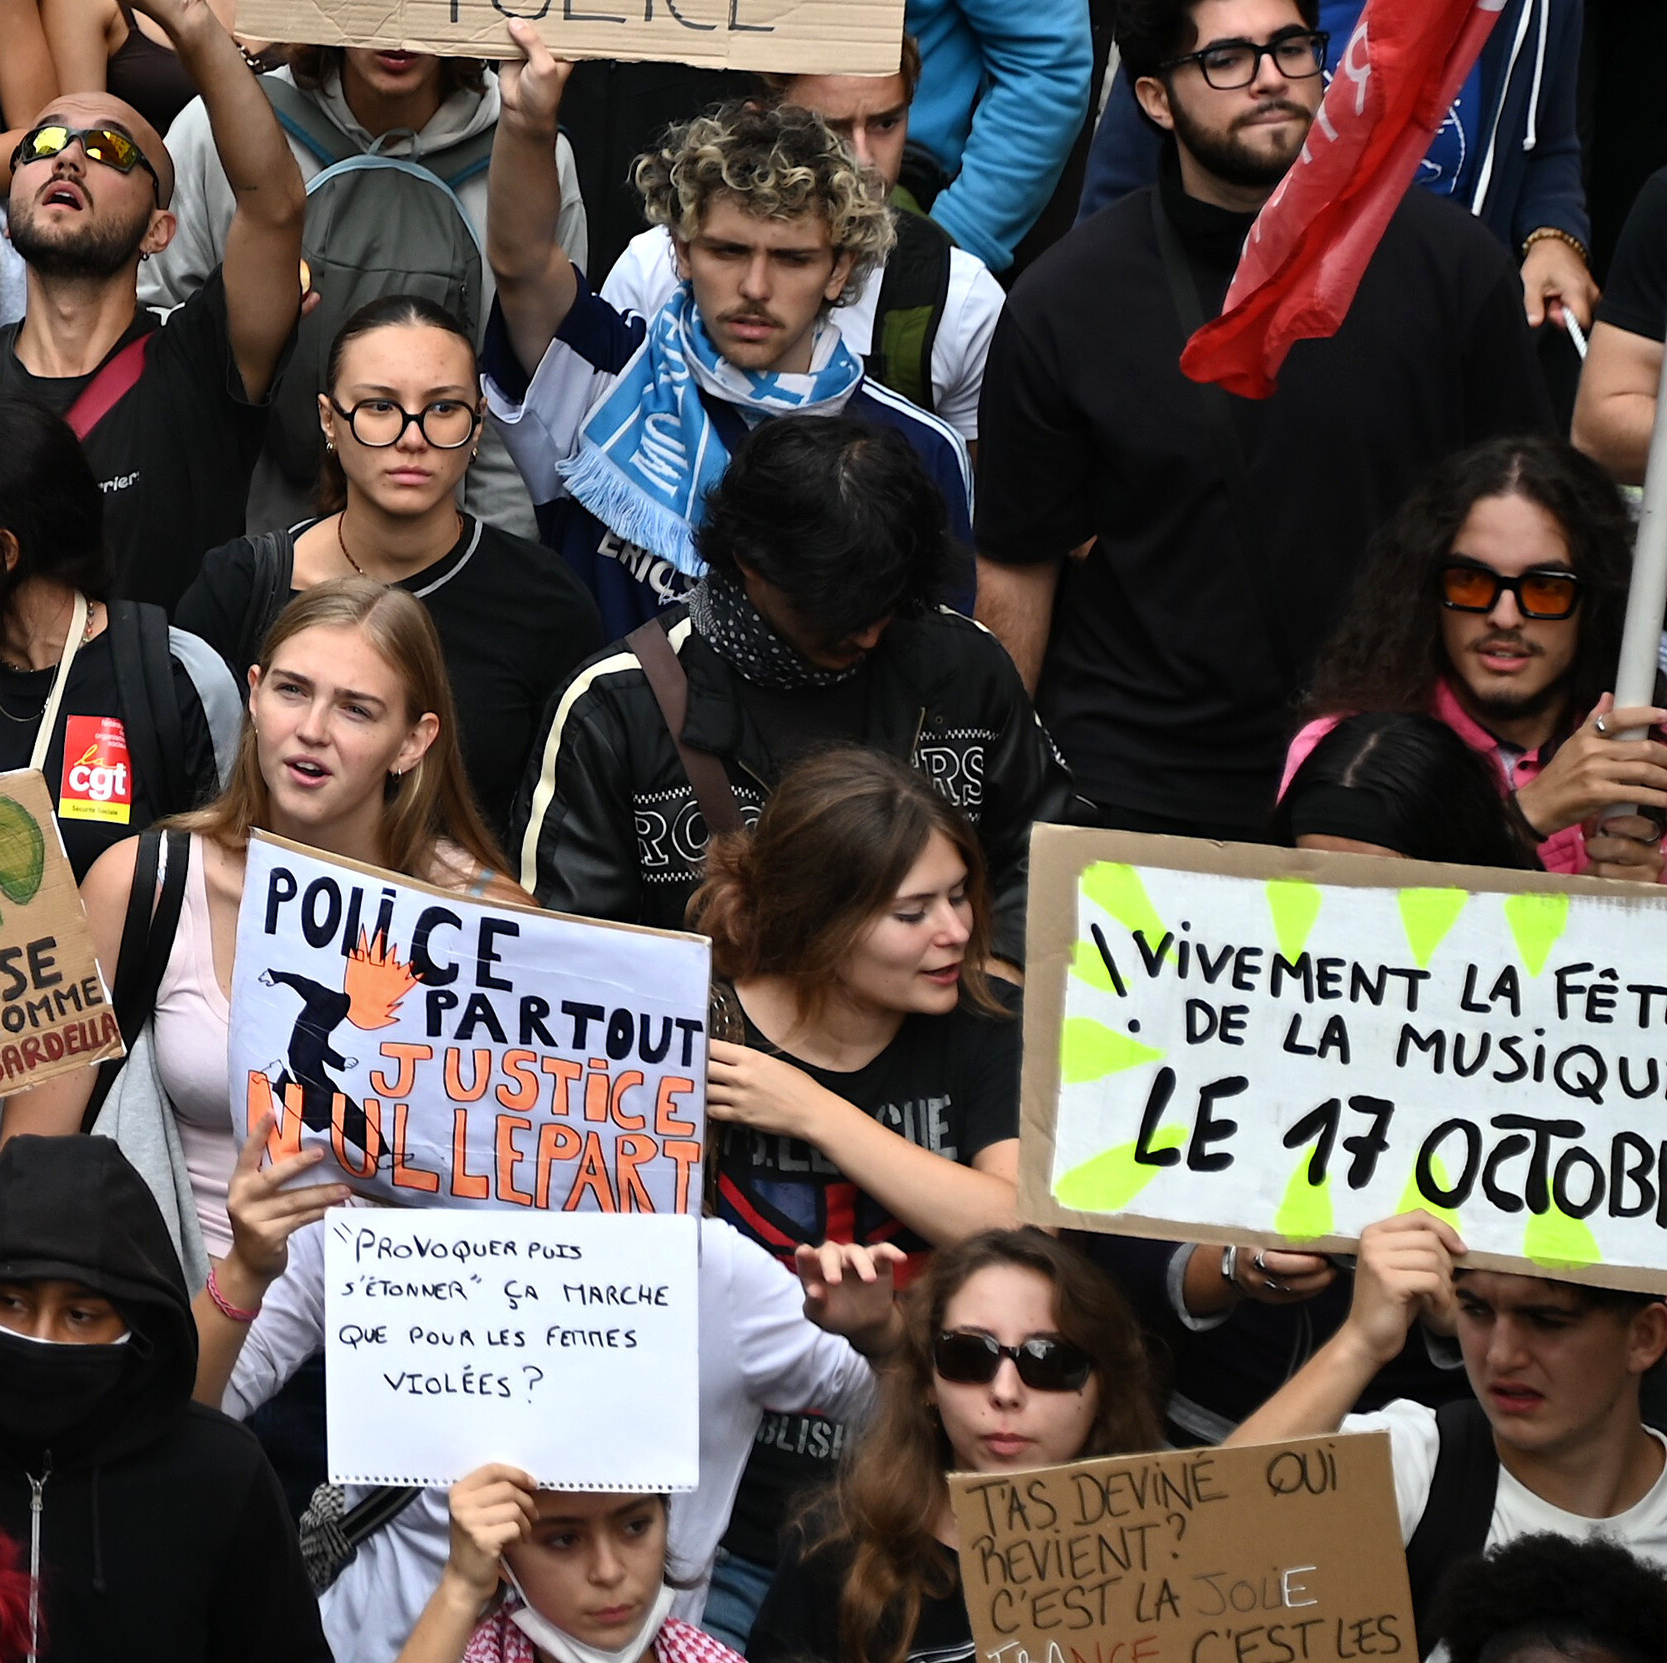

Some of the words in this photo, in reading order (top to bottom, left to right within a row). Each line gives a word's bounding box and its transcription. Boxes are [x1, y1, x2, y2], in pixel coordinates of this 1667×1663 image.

[68, 763, 127, 801] cgt
[265, 867, 520, 993] POLICE
[1132, 920, 1432, 1012] VIVEMENT
[1460, 962, 1521, 1018] LA
[426, 990, 702, 1067] PARTOUT
[1184, 997, 1250, 1046] DE
[1282, 1012, 1351, 1065] LA
[371, 1042, 694, 1137] JUSTICE
[1134, 1066, 1250, 1173] LE
[1282, 1094, 1395, 1190] 17
[528, 1242, 582, 1259] PUIS
[504, 1280, 539, 1310] ÇA
[564, 1283, 669, 1307] MARCHE
[339, 1324, 387, 1350] QUE
[410, 1327, 475, 1347] POUR
[488, 1328, 526, 1348] LES
[546, 1325, 638, 1348] FEMMES
[383, 1365, 512, 1398] VIOLÉES
[972, 1521, 1161, 1585] REVIENT
[991, 1577, 1122, 1635] C'EST
[1136, 1580, 1180, 1623] LA
[1336, 1614, 1402, 1658] LES
